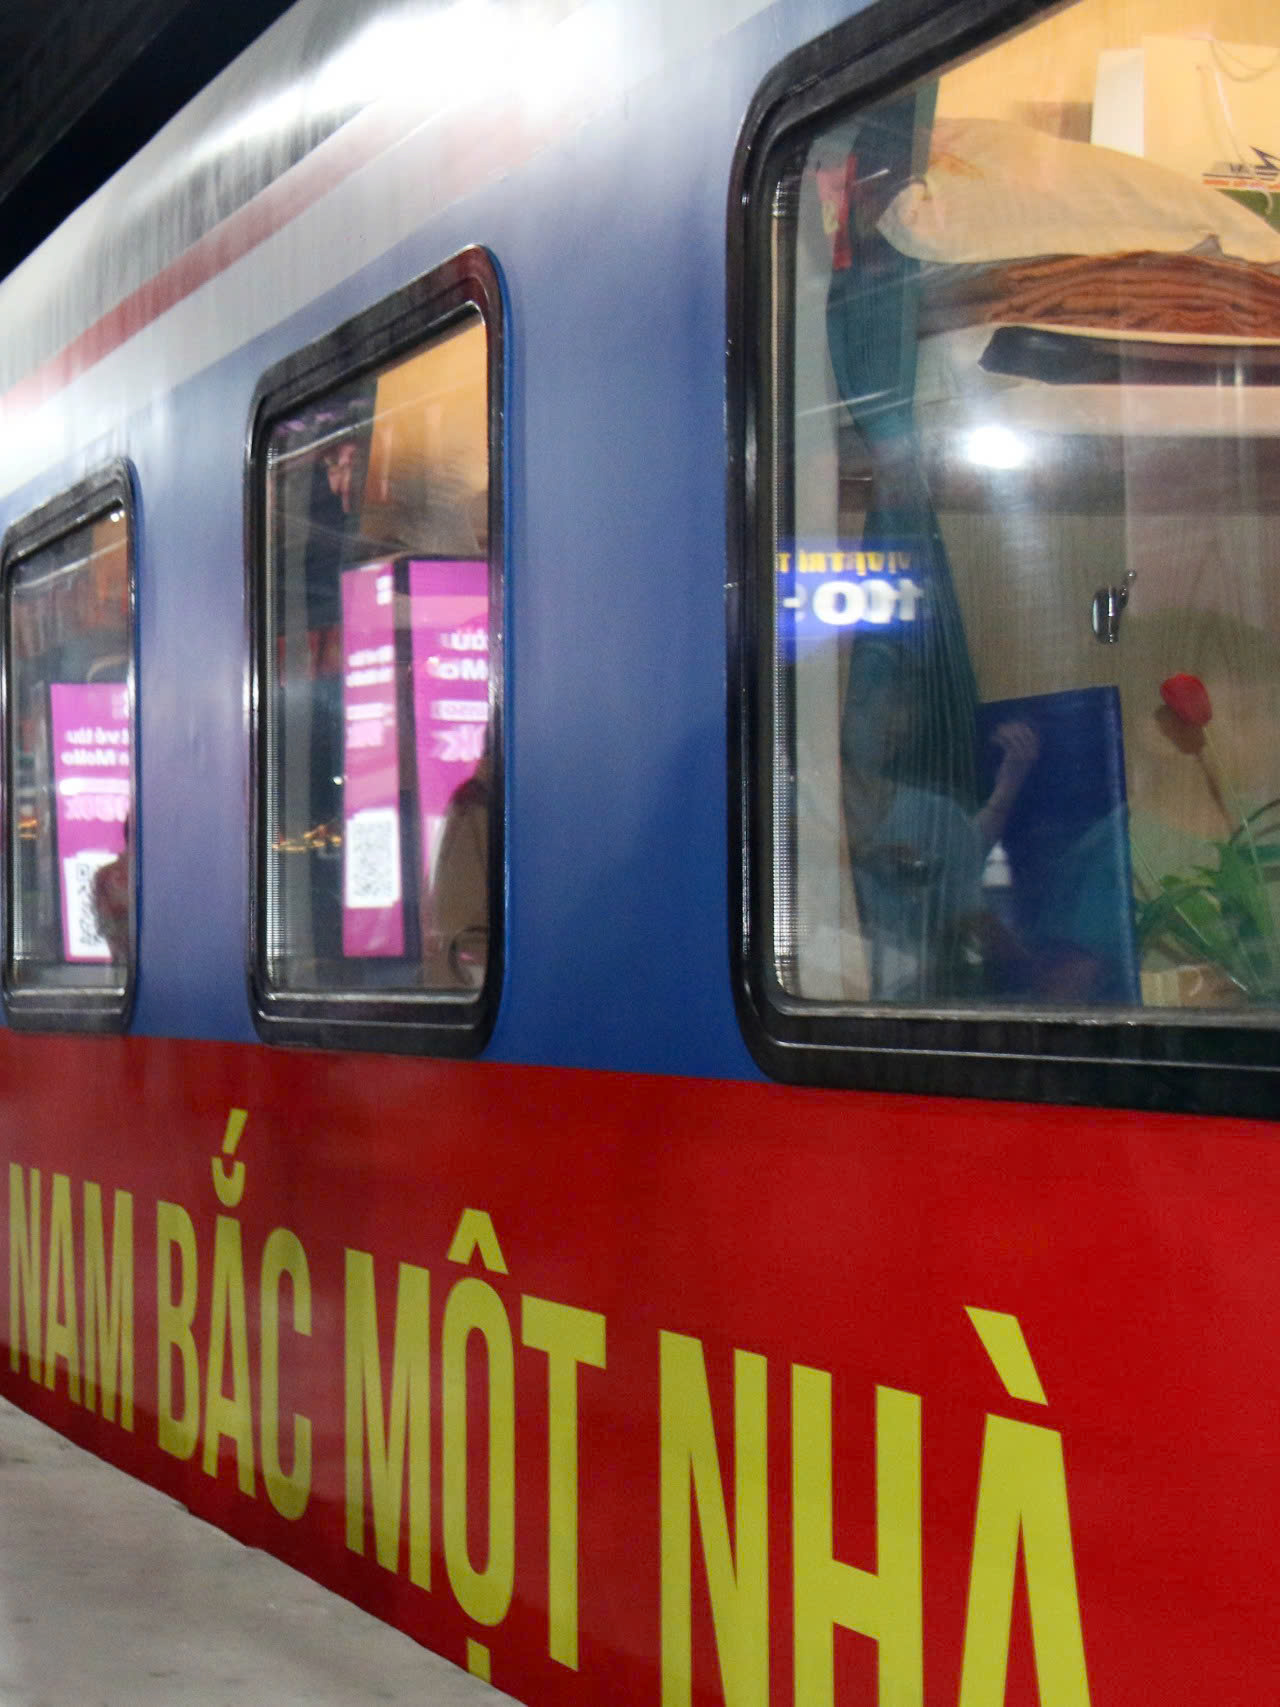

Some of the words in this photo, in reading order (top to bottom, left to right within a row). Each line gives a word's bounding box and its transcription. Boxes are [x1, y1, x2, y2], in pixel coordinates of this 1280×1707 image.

[10, 1163, 135, 1431] NAM
[157, 1109, 313, 1520] BẮC
[345, 1207, 607, 1684] MỘT
[659, 1305, 1092, 1707] NHÀ
